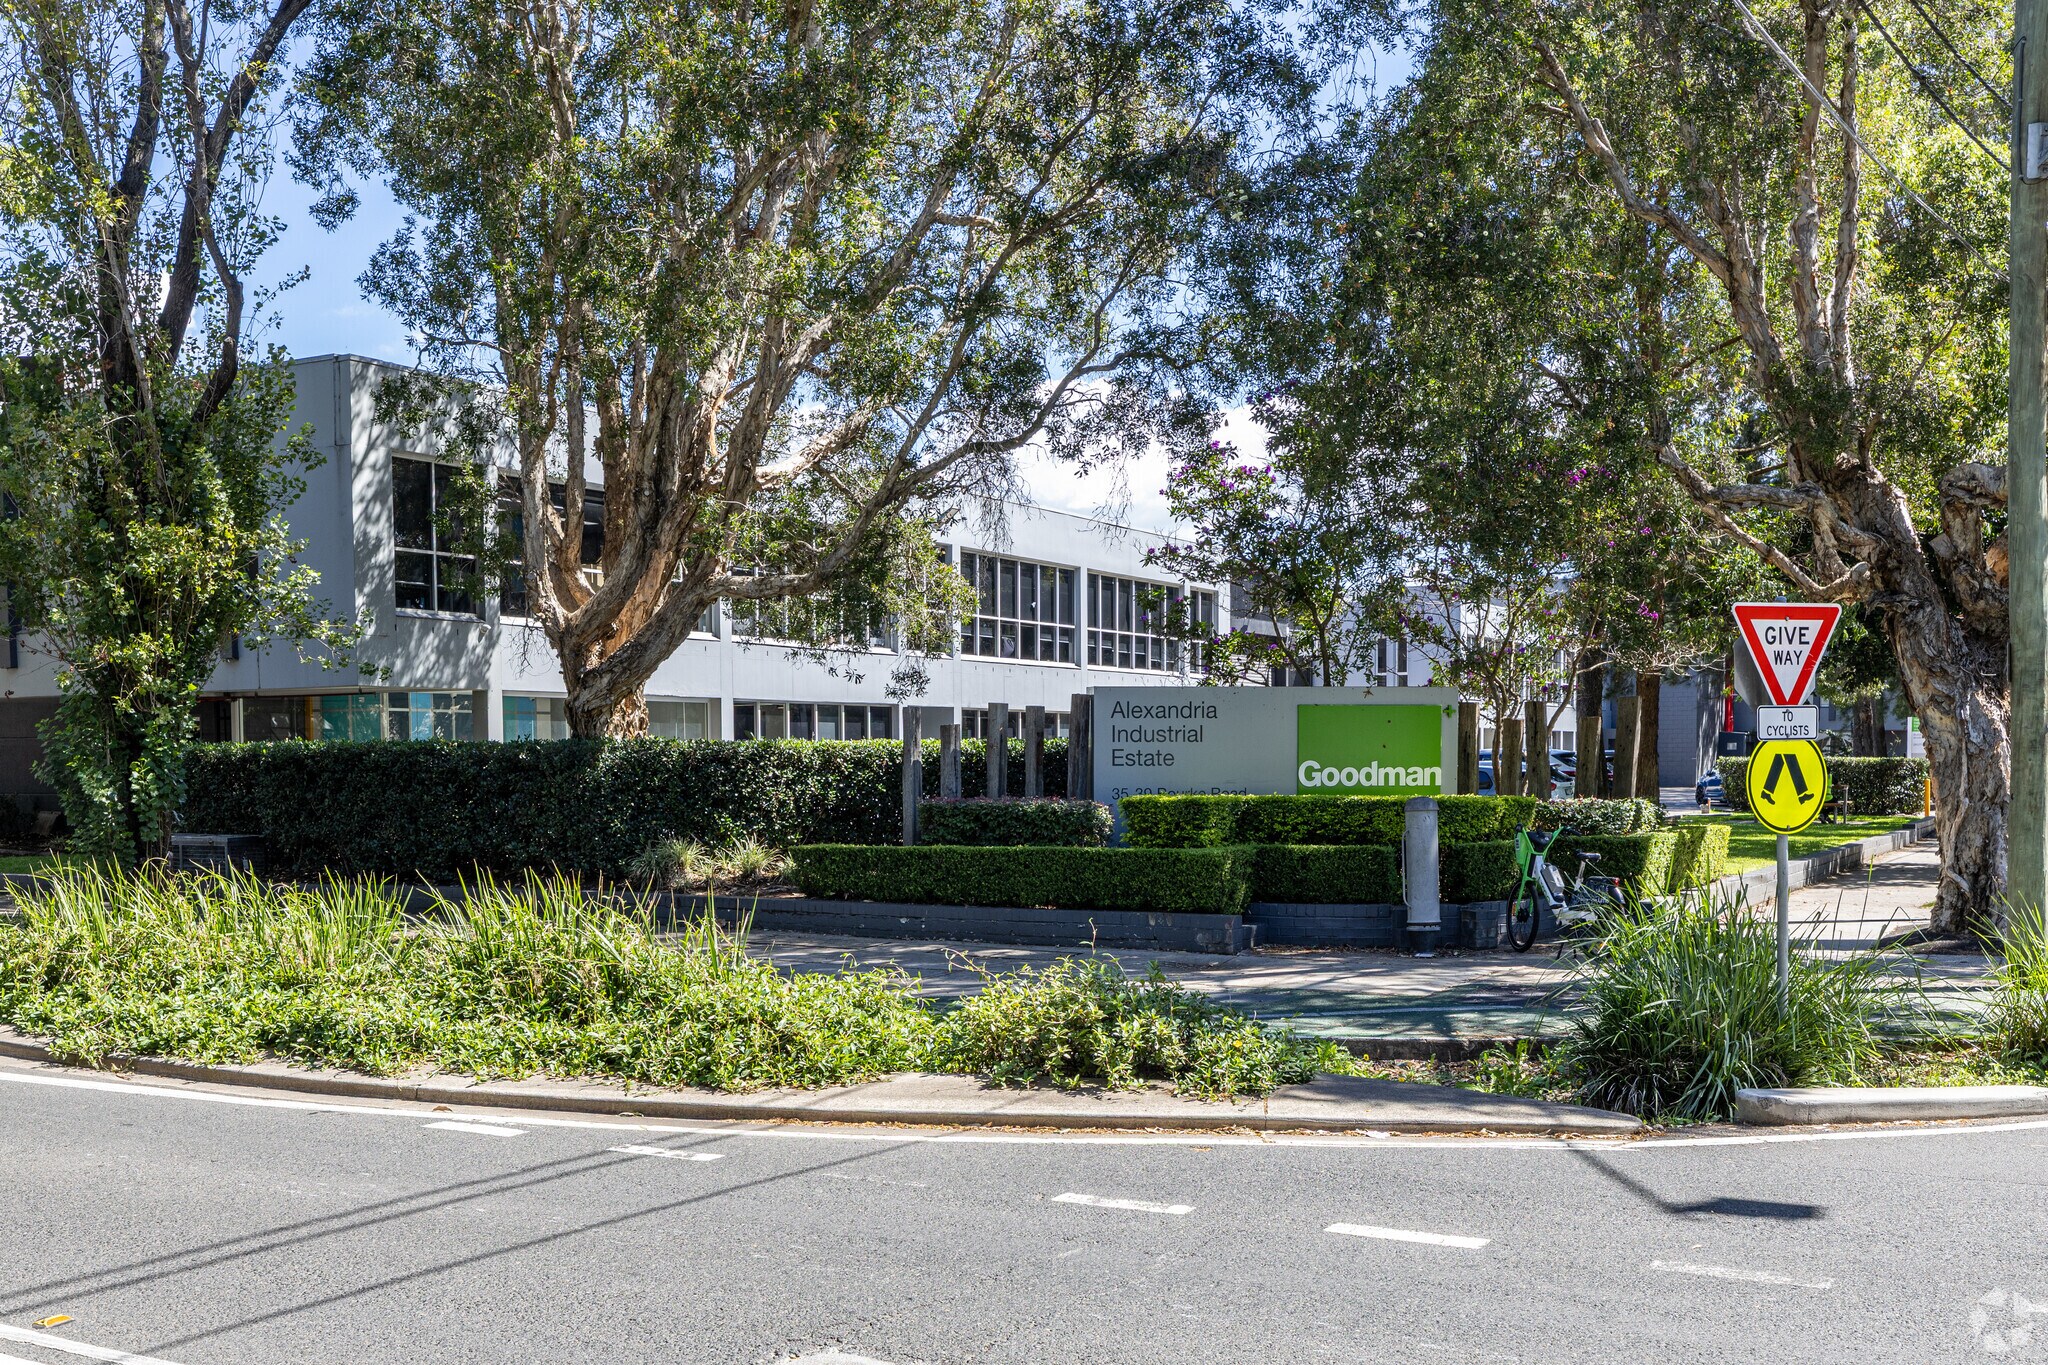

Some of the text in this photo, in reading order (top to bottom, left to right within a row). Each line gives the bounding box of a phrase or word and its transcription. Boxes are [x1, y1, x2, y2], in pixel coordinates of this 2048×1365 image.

[1764, 626, 1811, 646] GIVE
[1773, 650, 1804, 666] WAY
[1110, 701, 1218, 720] Alexandria
[1781, 711, 1794, 722] TO
[1111, 725, 1204, 744] Industrial
[1766, 725, 1810, 736] CYCLISTS
[1111, 749, 1176, 767] Estate
[1298, 760, 1443, 788] Goodman
[1111, 787, 1153, 800] 3539
